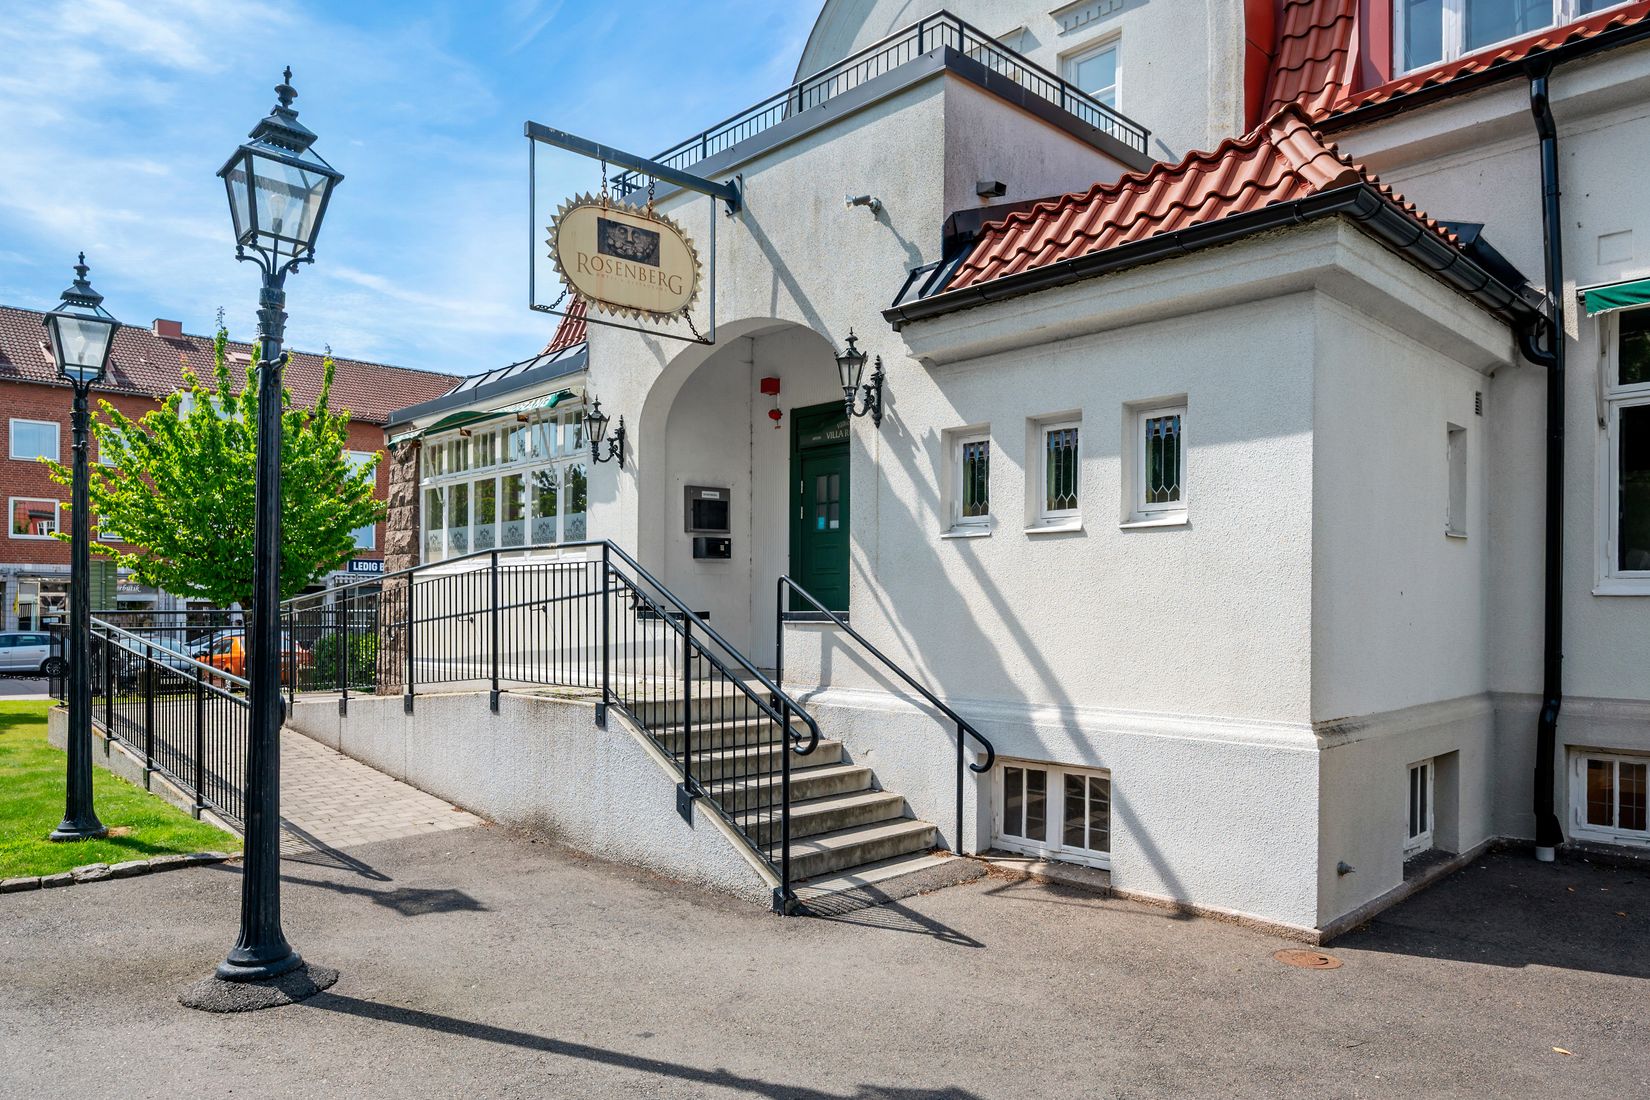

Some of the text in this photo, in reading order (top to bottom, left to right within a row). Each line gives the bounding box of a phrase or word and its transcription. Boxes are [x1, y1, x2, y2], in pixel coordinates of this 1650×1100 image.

[576, 252, 683, 295] ROSENBERG
[826, 429, 844, 440] VILLA
[353, 561, 378, 571] LEDIG
